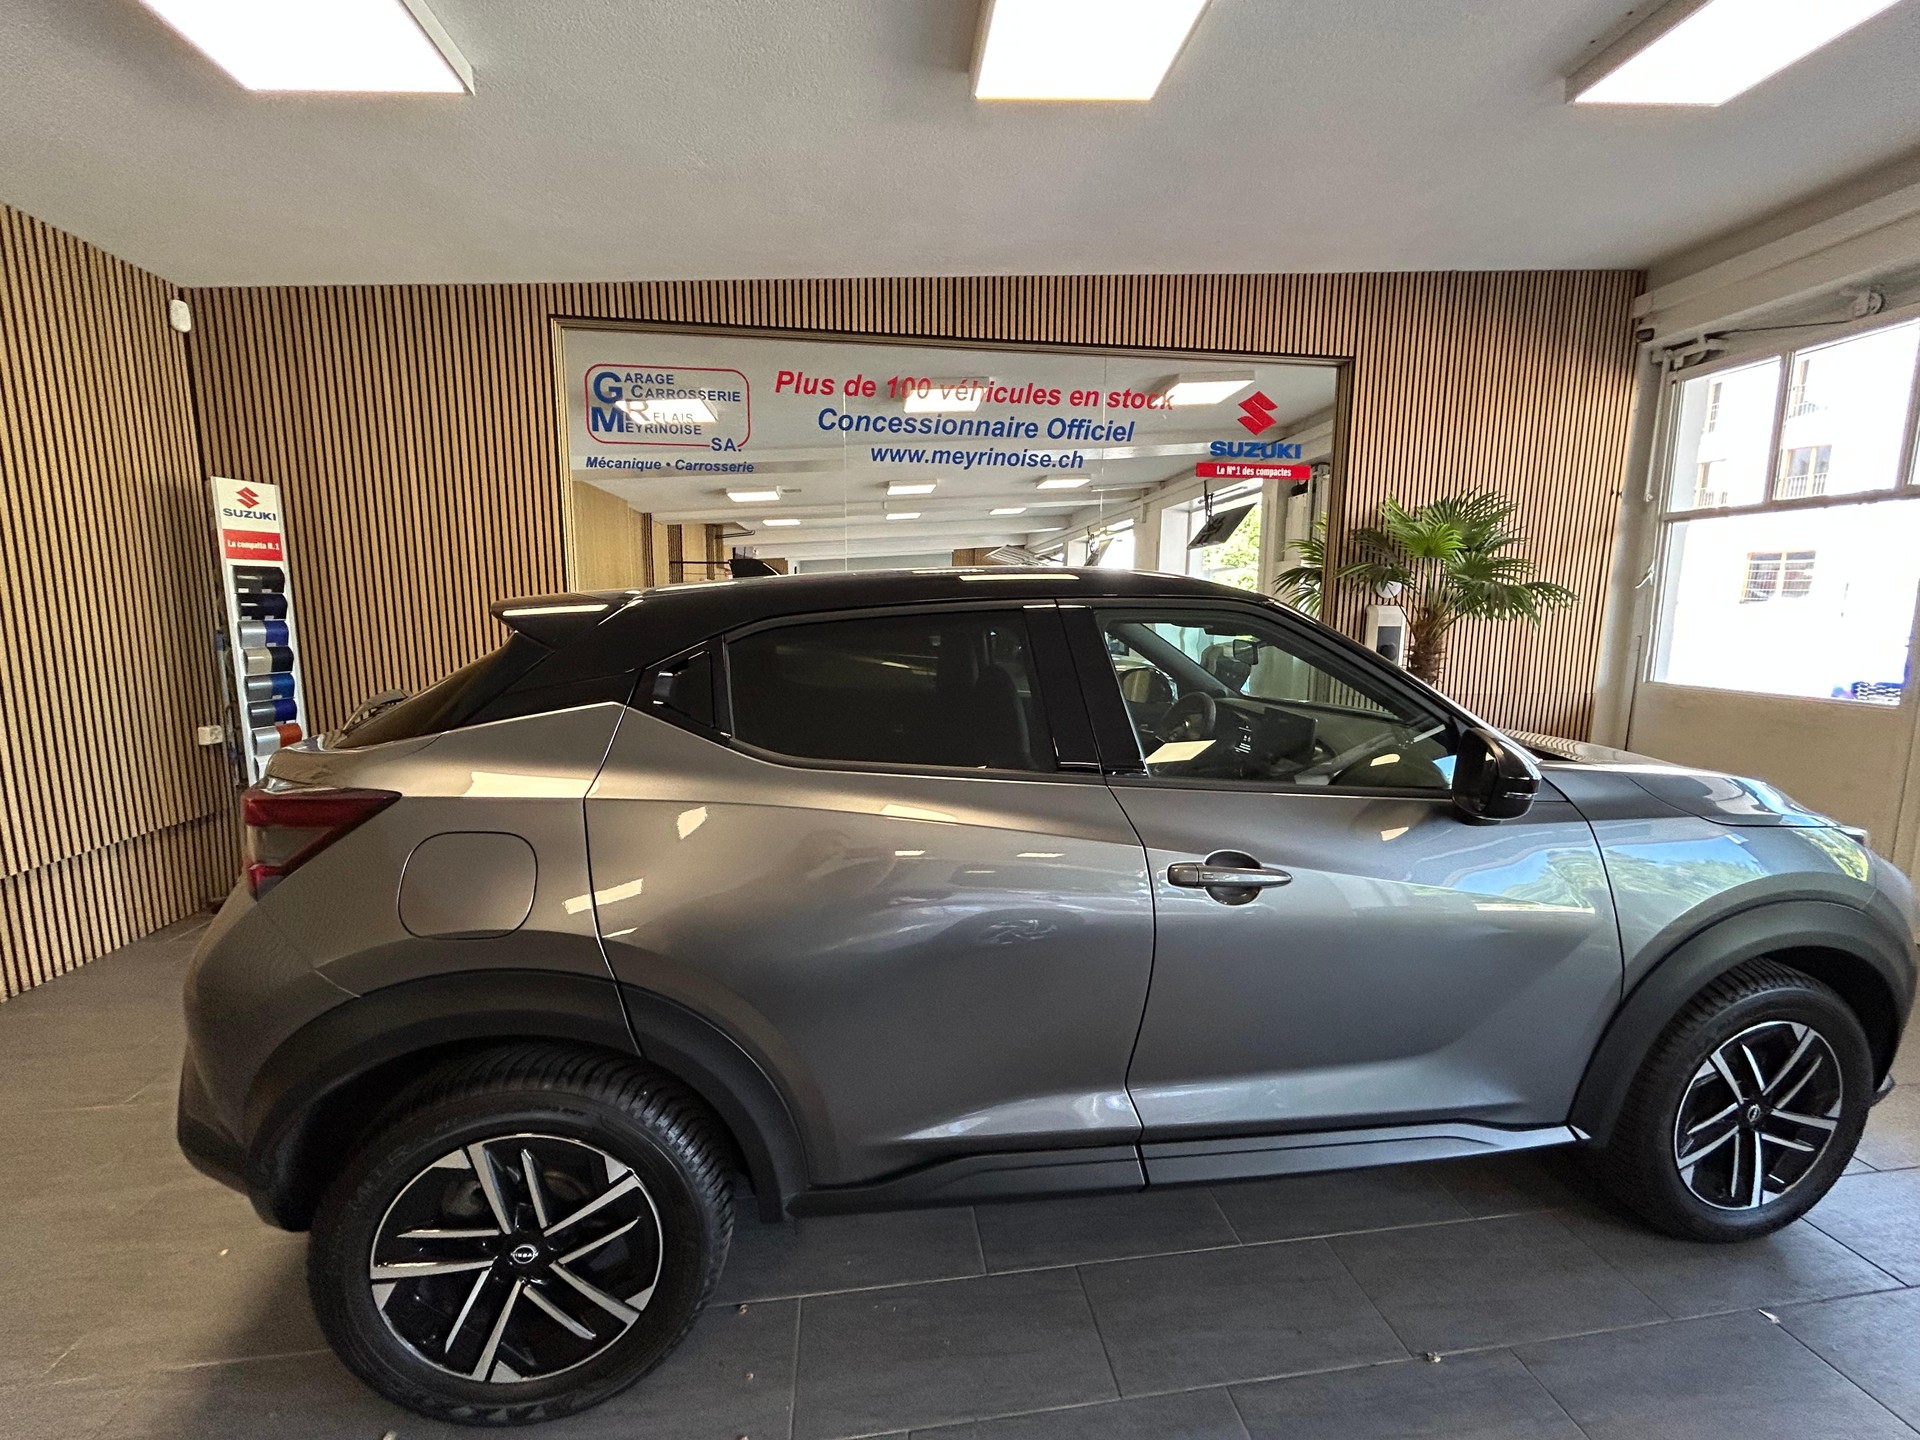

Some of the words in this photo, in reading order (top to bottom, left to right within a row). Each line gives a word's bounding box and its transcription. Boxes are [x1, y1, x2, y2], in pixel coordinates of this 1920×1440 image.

[593, 371, 675, 404] GARAGE
[630, 385, 741, 402] CARROSSERIE
[775, 370, 836, 396] Plus
[844, 374, 877, 398] de
[887, 375, 932, 399] 100
[940, 378, 1061, 406] véhicules
[1069, 388, 1100, 407] en
[1107, 387, 1175, 411] stock
[591, 406, 702, 434] MEYRINOISE
[818, 407, 1039, 439] Concessionnaire
[1047, 417, 1136, 442] Officiel
[711, 438, 742, 452] SA.
[1209, 440, 1303, 459] SUZUKI
[585, 456, 662, 473] Mécanique
[674, 459, 755, 474] Carrosserie
[870, 447, 1084, 470] www.meyrinoise.ch
[1216, 465, 1225, 475] Le
[1242, 466, 1255, 476] des
[1256, 467, 1292, 477] compactes
[223, 508, 277, 521] SUZUKI
[227, 539, 236, 548] La
